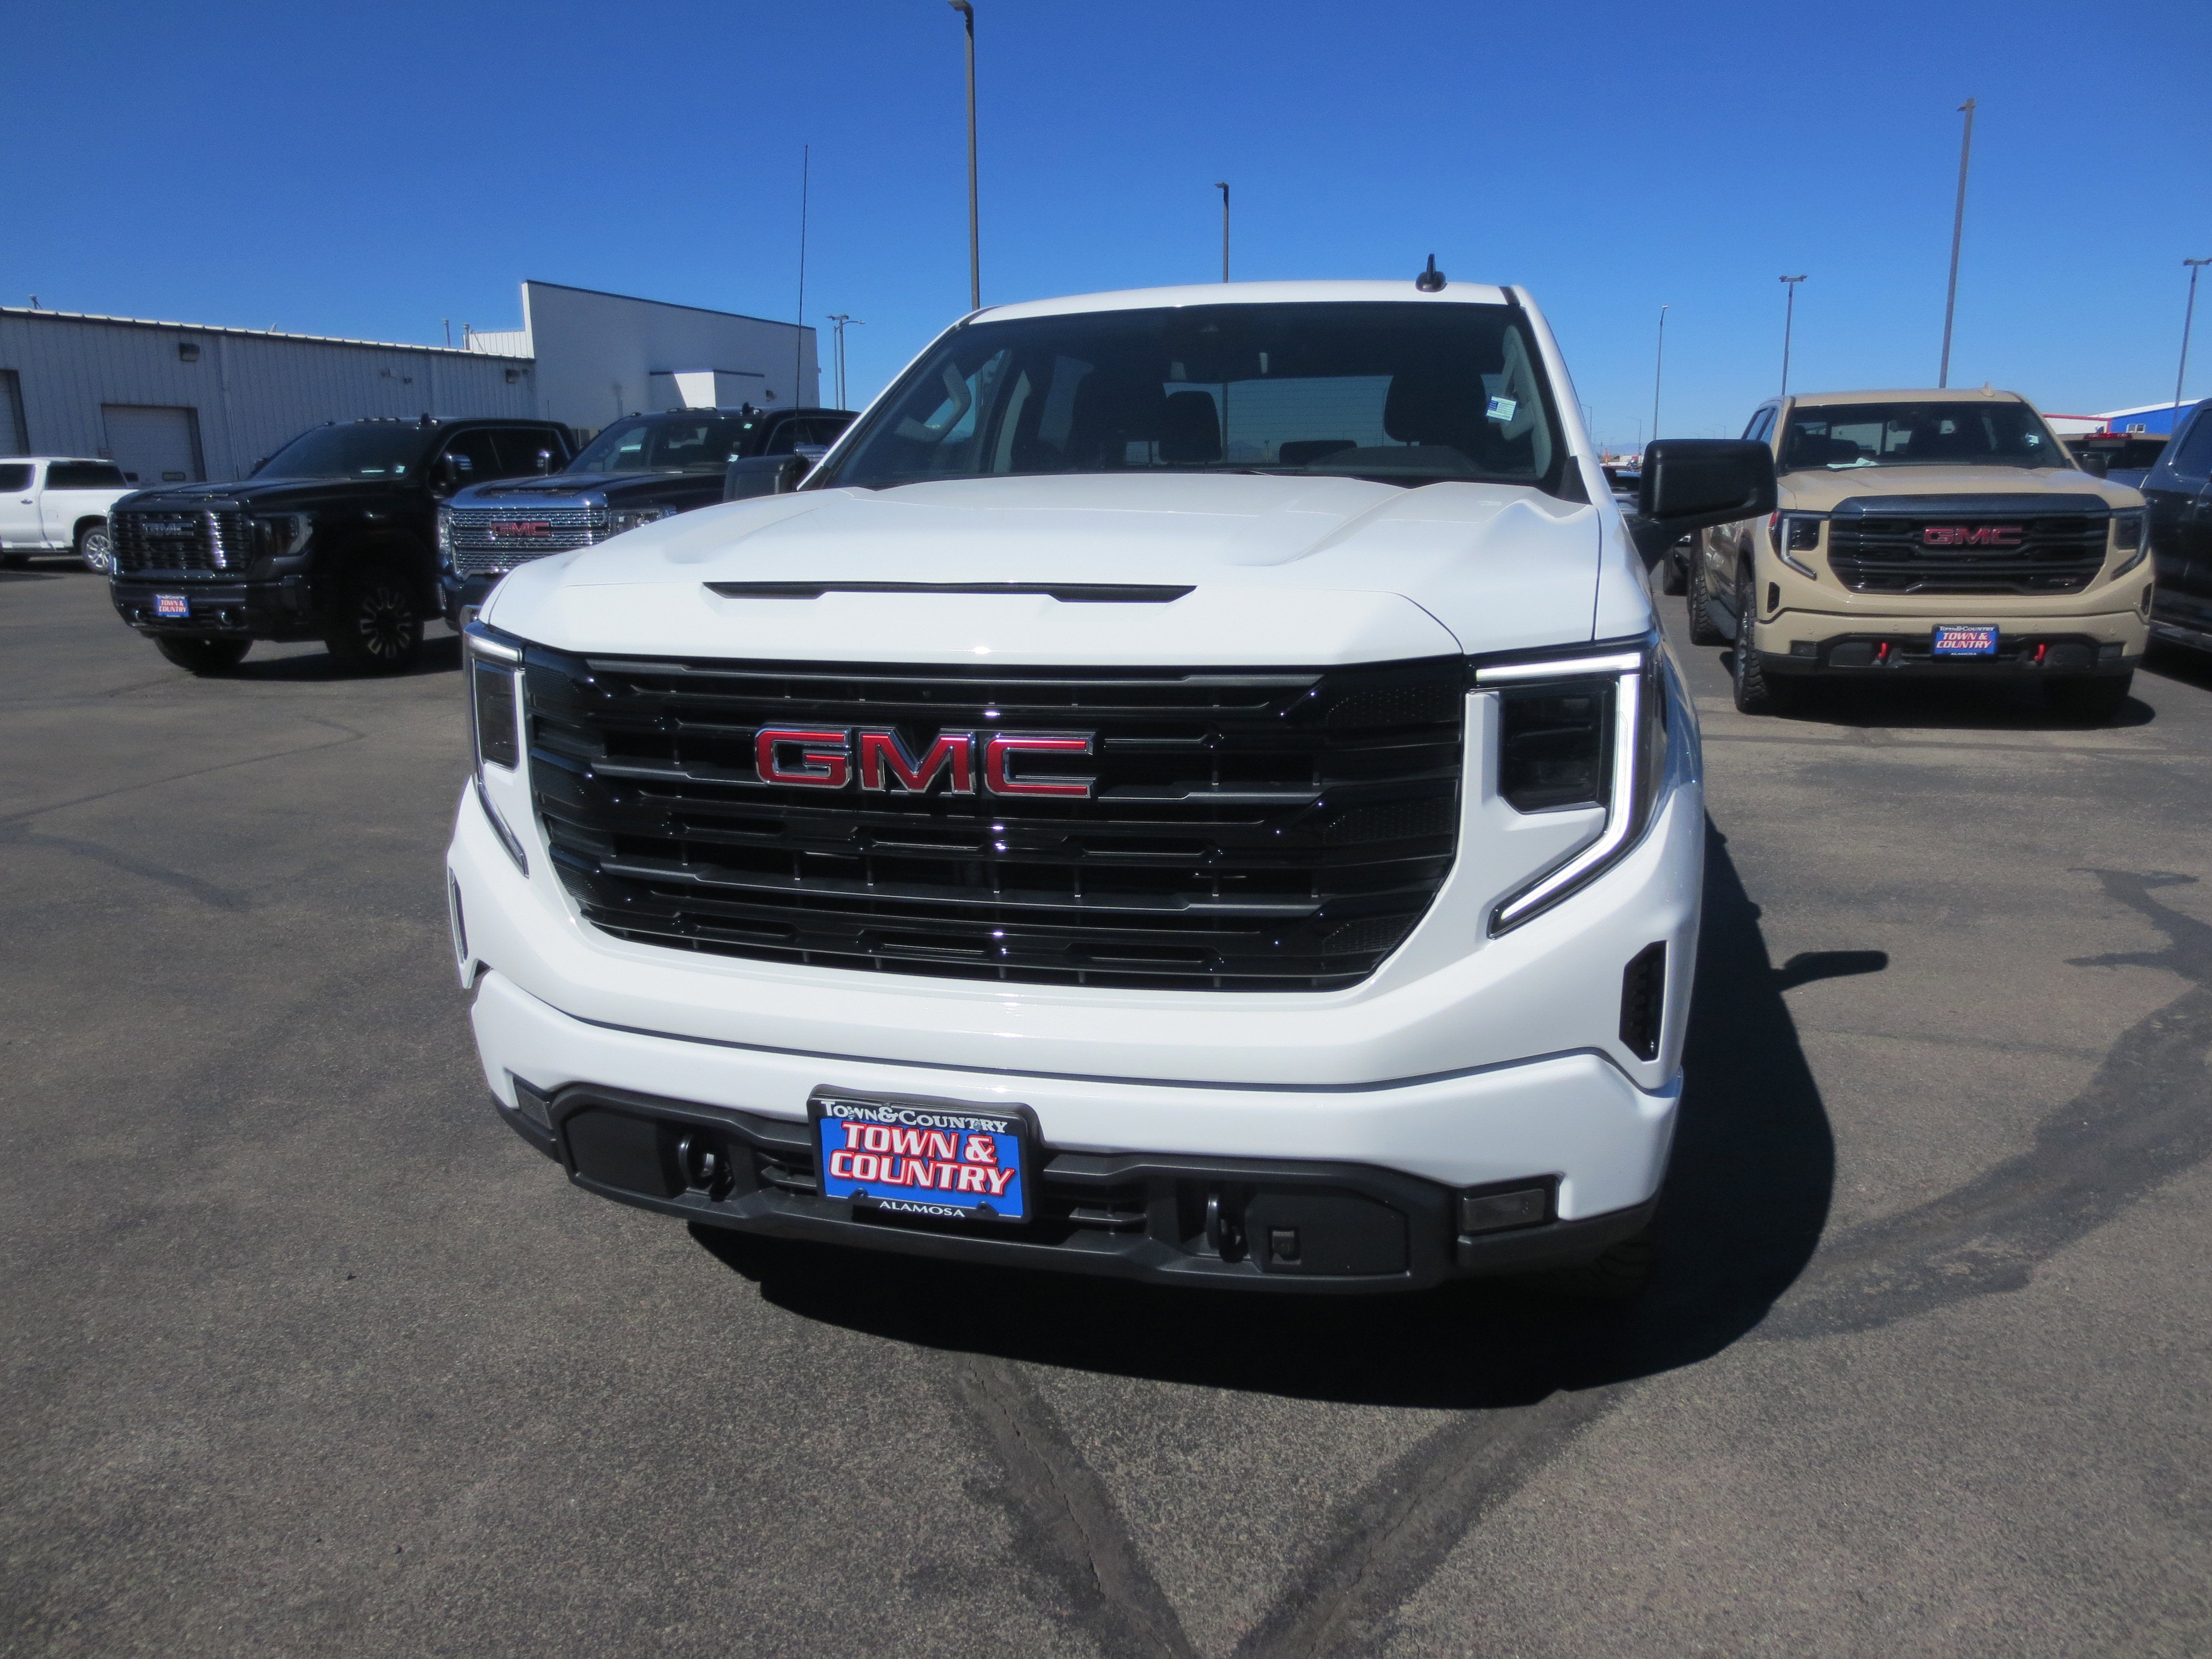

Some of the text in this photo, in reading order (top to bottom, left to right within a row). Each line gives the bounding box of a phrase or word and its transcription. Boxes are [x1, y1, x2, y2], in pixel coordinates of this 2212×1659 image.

[491, 521, 552, 537] GMC
[1923, 527, 2022, 544] GMC
[1936, 640, 1993, 649] COUNTRY
[1978, 632, 1989, 640] &
[755, 723, 1097, 798] GMC
[842, 1121, 998, 1165] TOWN &
[828, 1149, 1015, 1195] COUNTRY
[879, 1201, 965, 1218] ALAMOSA
